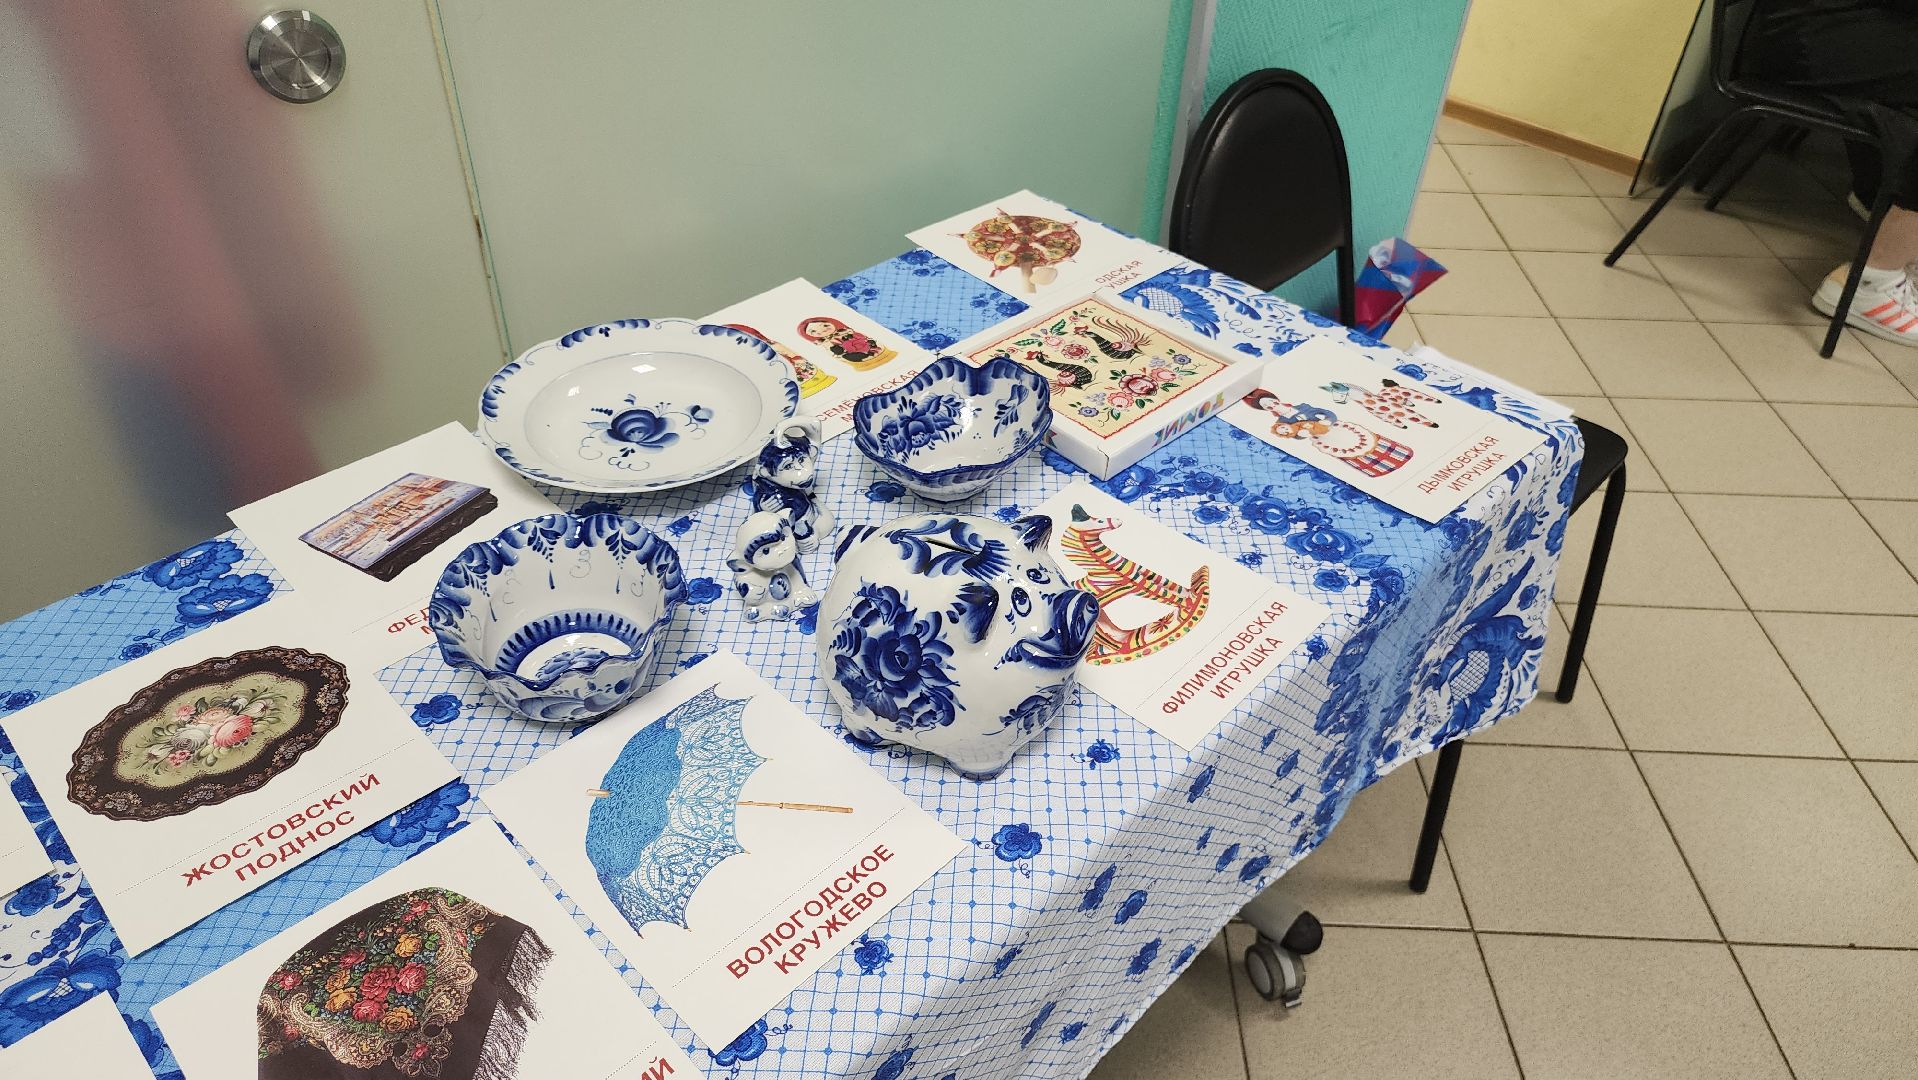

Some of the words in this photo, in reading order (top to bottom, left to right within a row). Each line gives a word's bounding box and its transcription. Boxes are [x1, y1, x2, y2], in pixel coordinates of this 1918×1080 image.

[1095, 260, 1142, 284] ОДСКАЯ
[1106, 272, 1142, 290] УШКА
[1417, 435, 1499, 494] ДЫМКОВСКАЯ
[1448, 451, 1506, 492] ИГРУШКА
[1162, 601, 1288, 714] ФИЛИМОНОВСКАЯ
[1209, 637, 1284, 699] ИГРУШКА
[180, 773, 380, 887] ЖОСТОВСКИЙ
[234, 810, 355, 881] ПОДНОС
[726, 844, 895, 979] ВОЛОГОДСКОЕ
[773, 881, 887, 975] КРУЖЕВО
